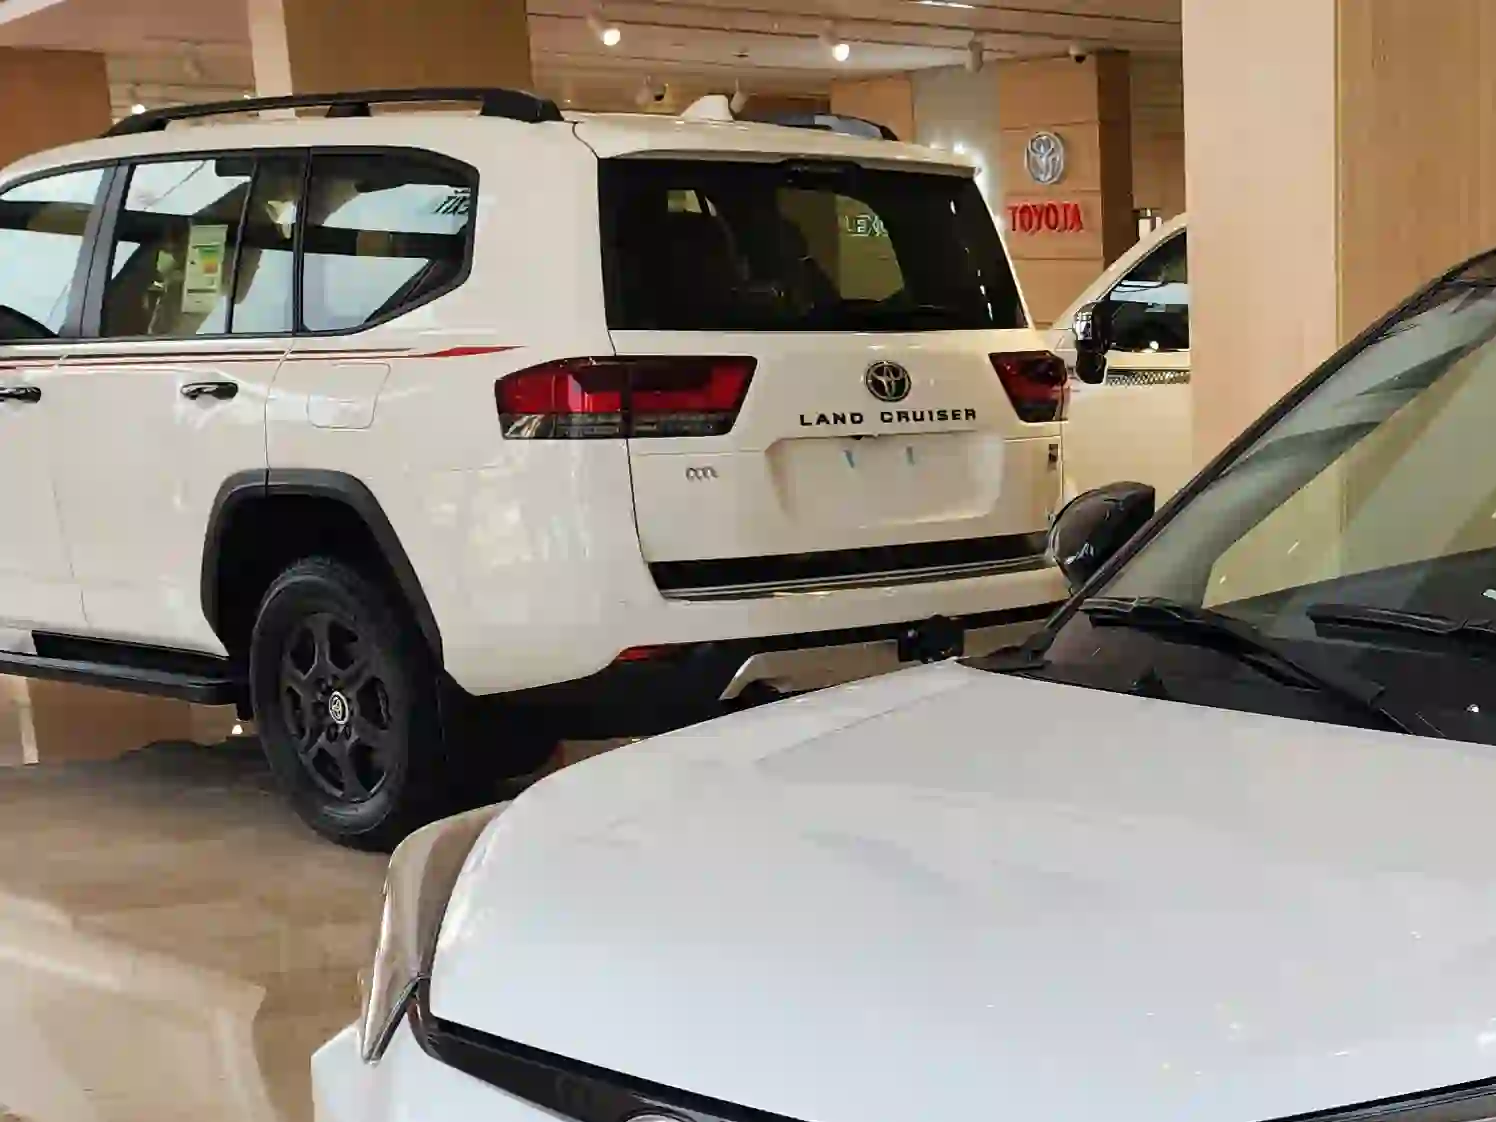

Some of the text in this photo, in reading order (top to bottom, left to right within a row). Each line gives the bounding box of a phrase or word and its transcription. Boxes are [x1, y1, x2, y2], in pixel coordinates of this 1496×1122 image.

[1007, 203, 1084, 232] TOYOTA
[799, 408, 977, 426] LAND CRUISER
